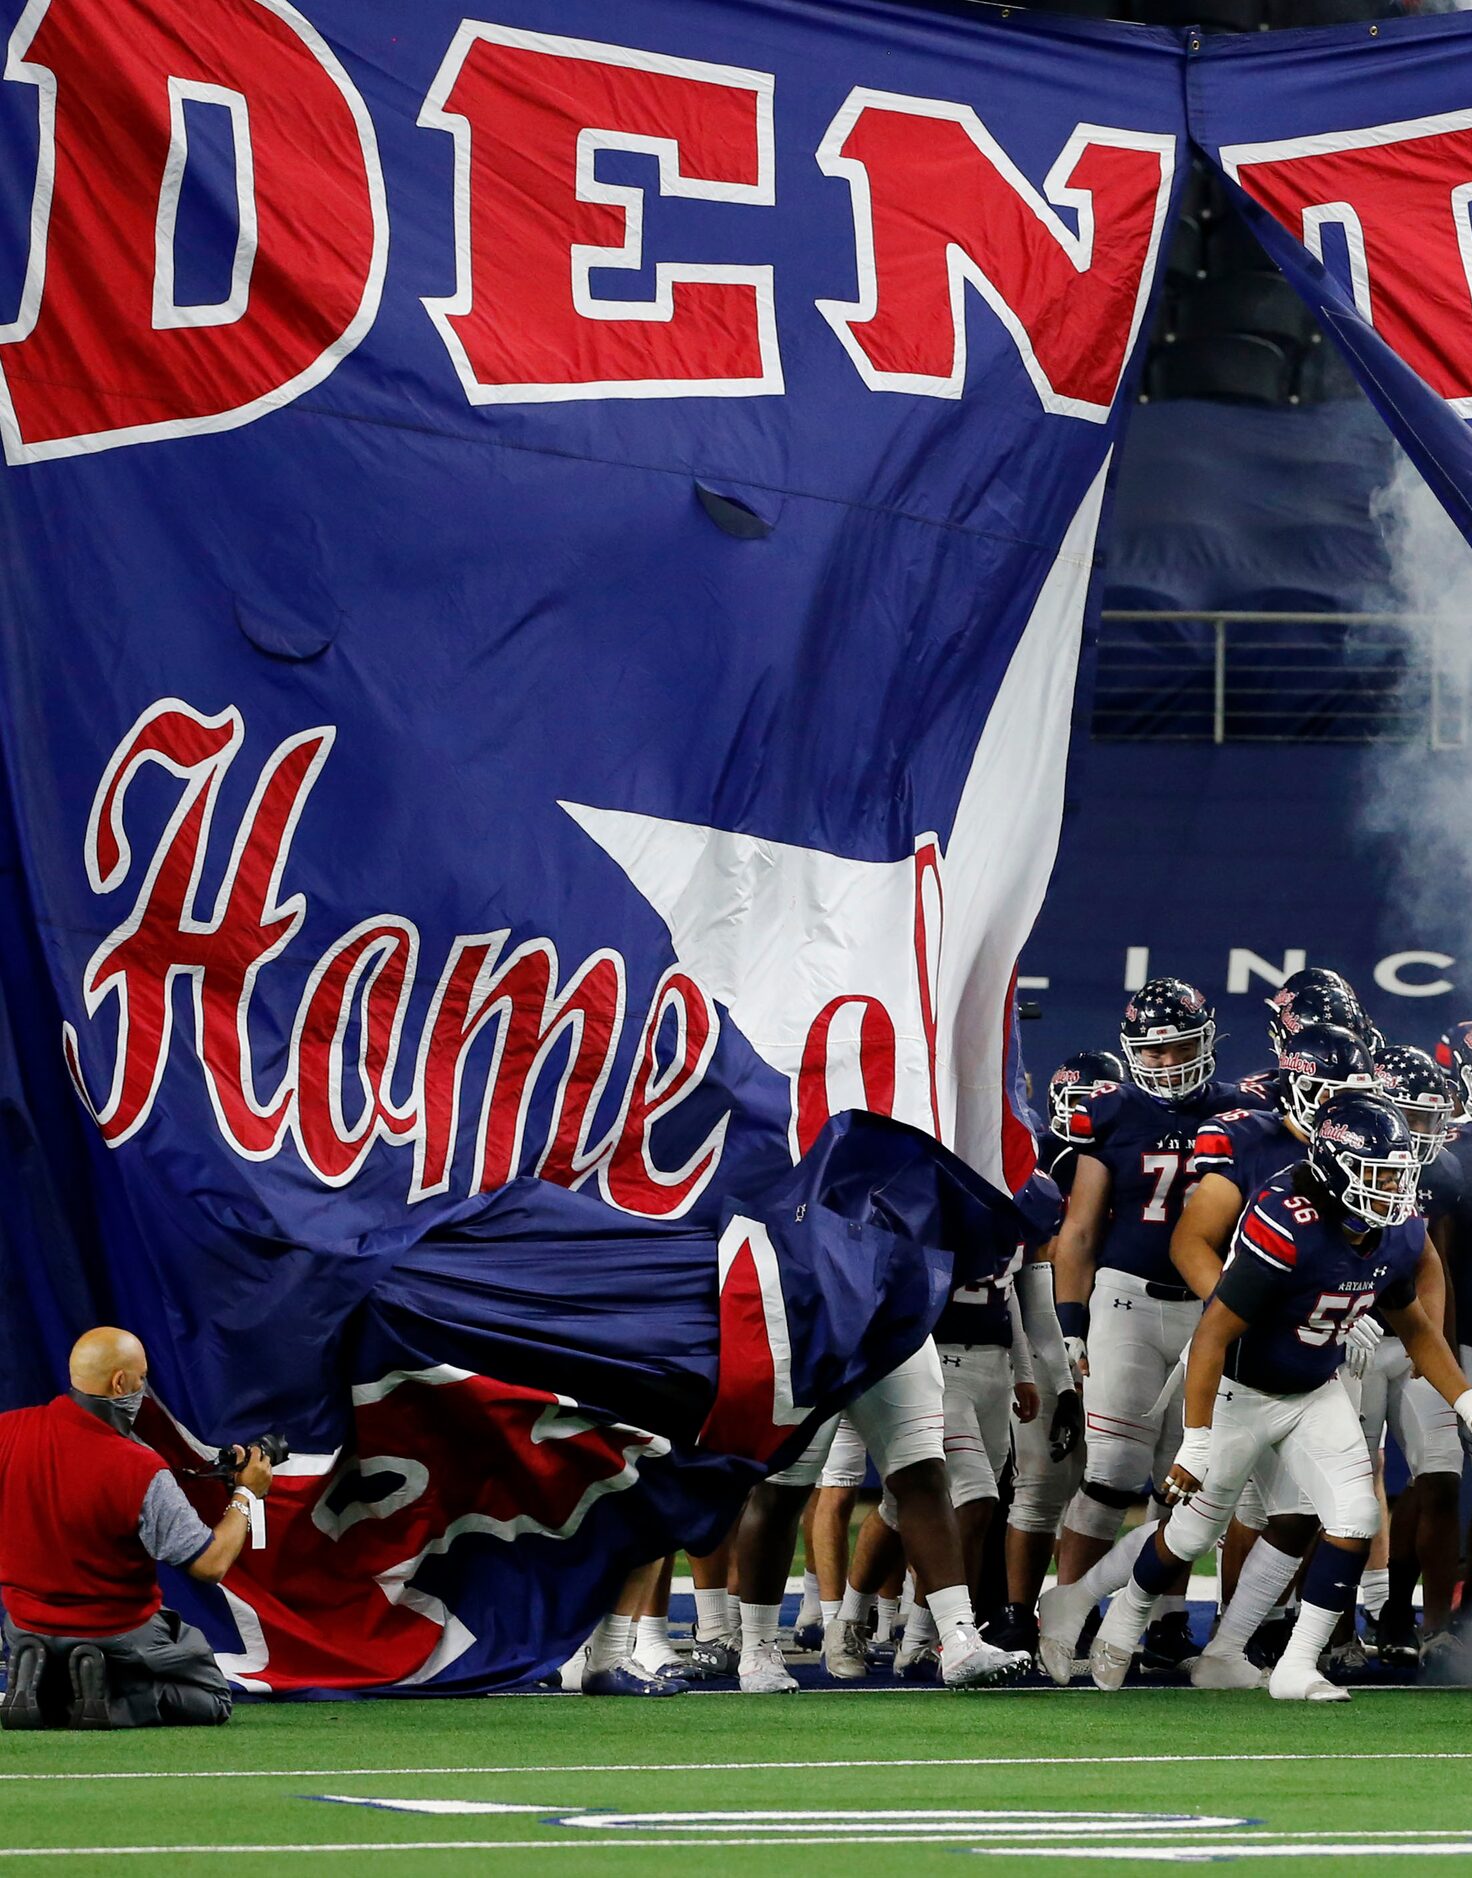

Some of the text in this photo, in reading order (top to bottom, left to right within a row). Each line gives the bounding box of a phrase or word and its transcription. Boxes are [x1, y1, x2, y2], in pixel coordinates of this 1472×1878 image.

[62, 697, 732, 1219] Home
[1283, 1195, 1320, 1225] 56
[1344, 1281, 1370, 1292] RYAN
[1296, 1292, 1377, 1347] 56
